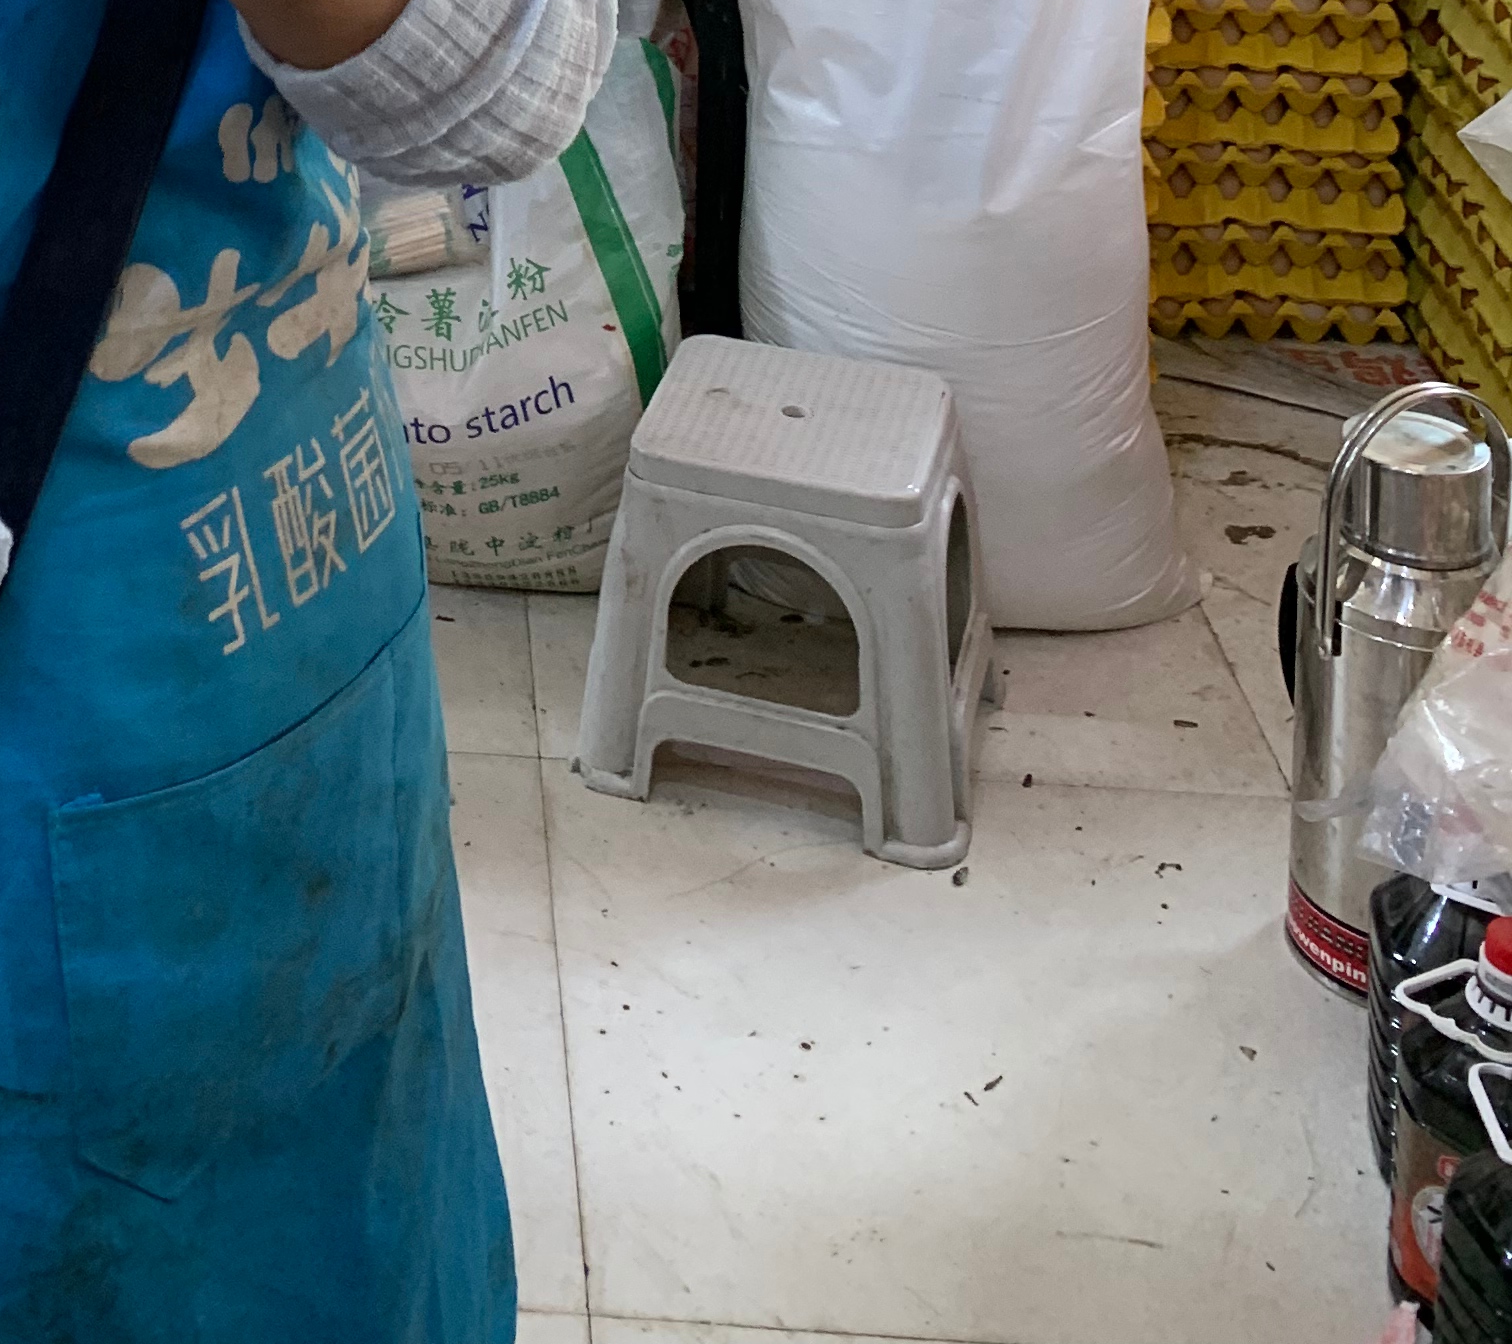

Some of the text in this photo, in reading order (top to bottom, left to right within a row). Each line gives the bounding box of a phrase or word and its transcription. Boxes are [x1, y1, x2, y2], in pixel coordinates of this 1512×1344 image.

[466, 375, 575, 439] starch
[180, 388, 394, 654] 乳酸菌
